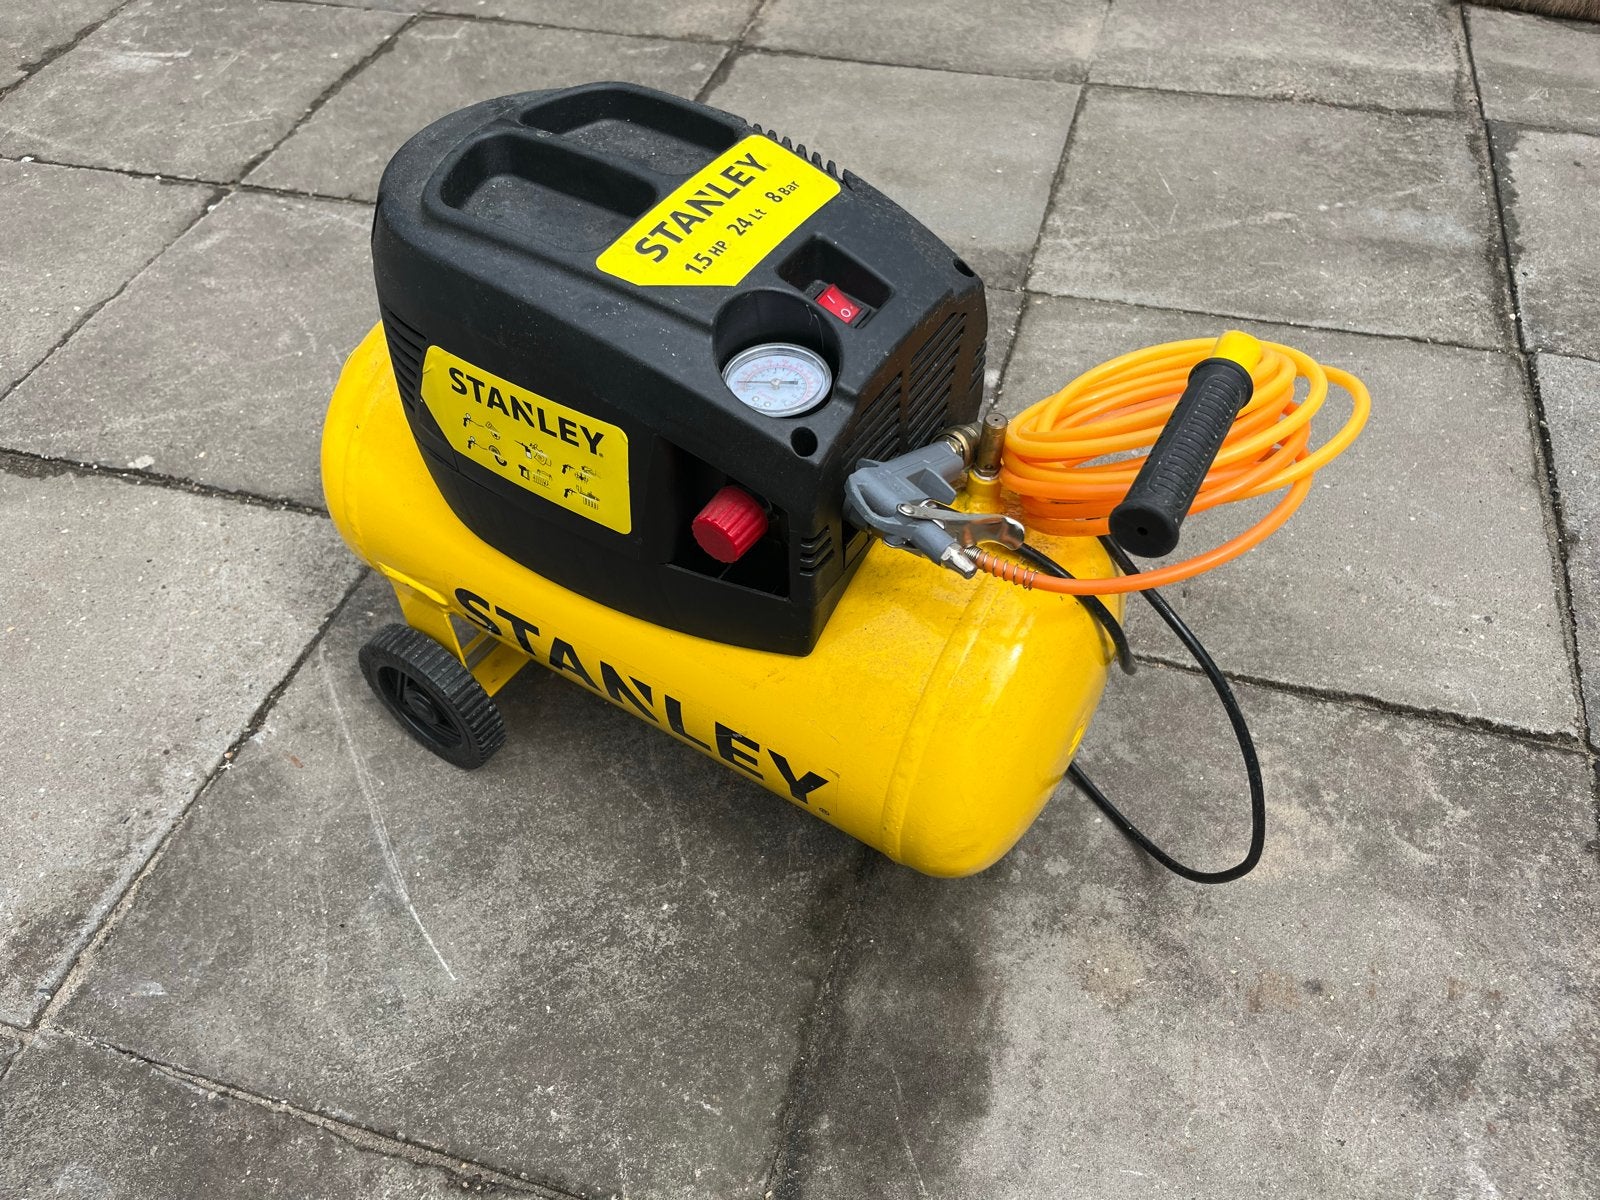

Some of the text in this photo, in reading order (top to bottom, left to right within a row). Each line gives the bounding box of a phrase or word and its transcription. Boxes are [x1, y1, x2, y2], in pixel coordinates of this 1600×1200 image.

[634, 152, 768, 264] STANLEY
[685, 179, 801, 275] 1.5 HP 24 Lt 8 Bar
[449, 367, 605, 456] STANLEY
[454, 587, 829, 804] STANLEY
